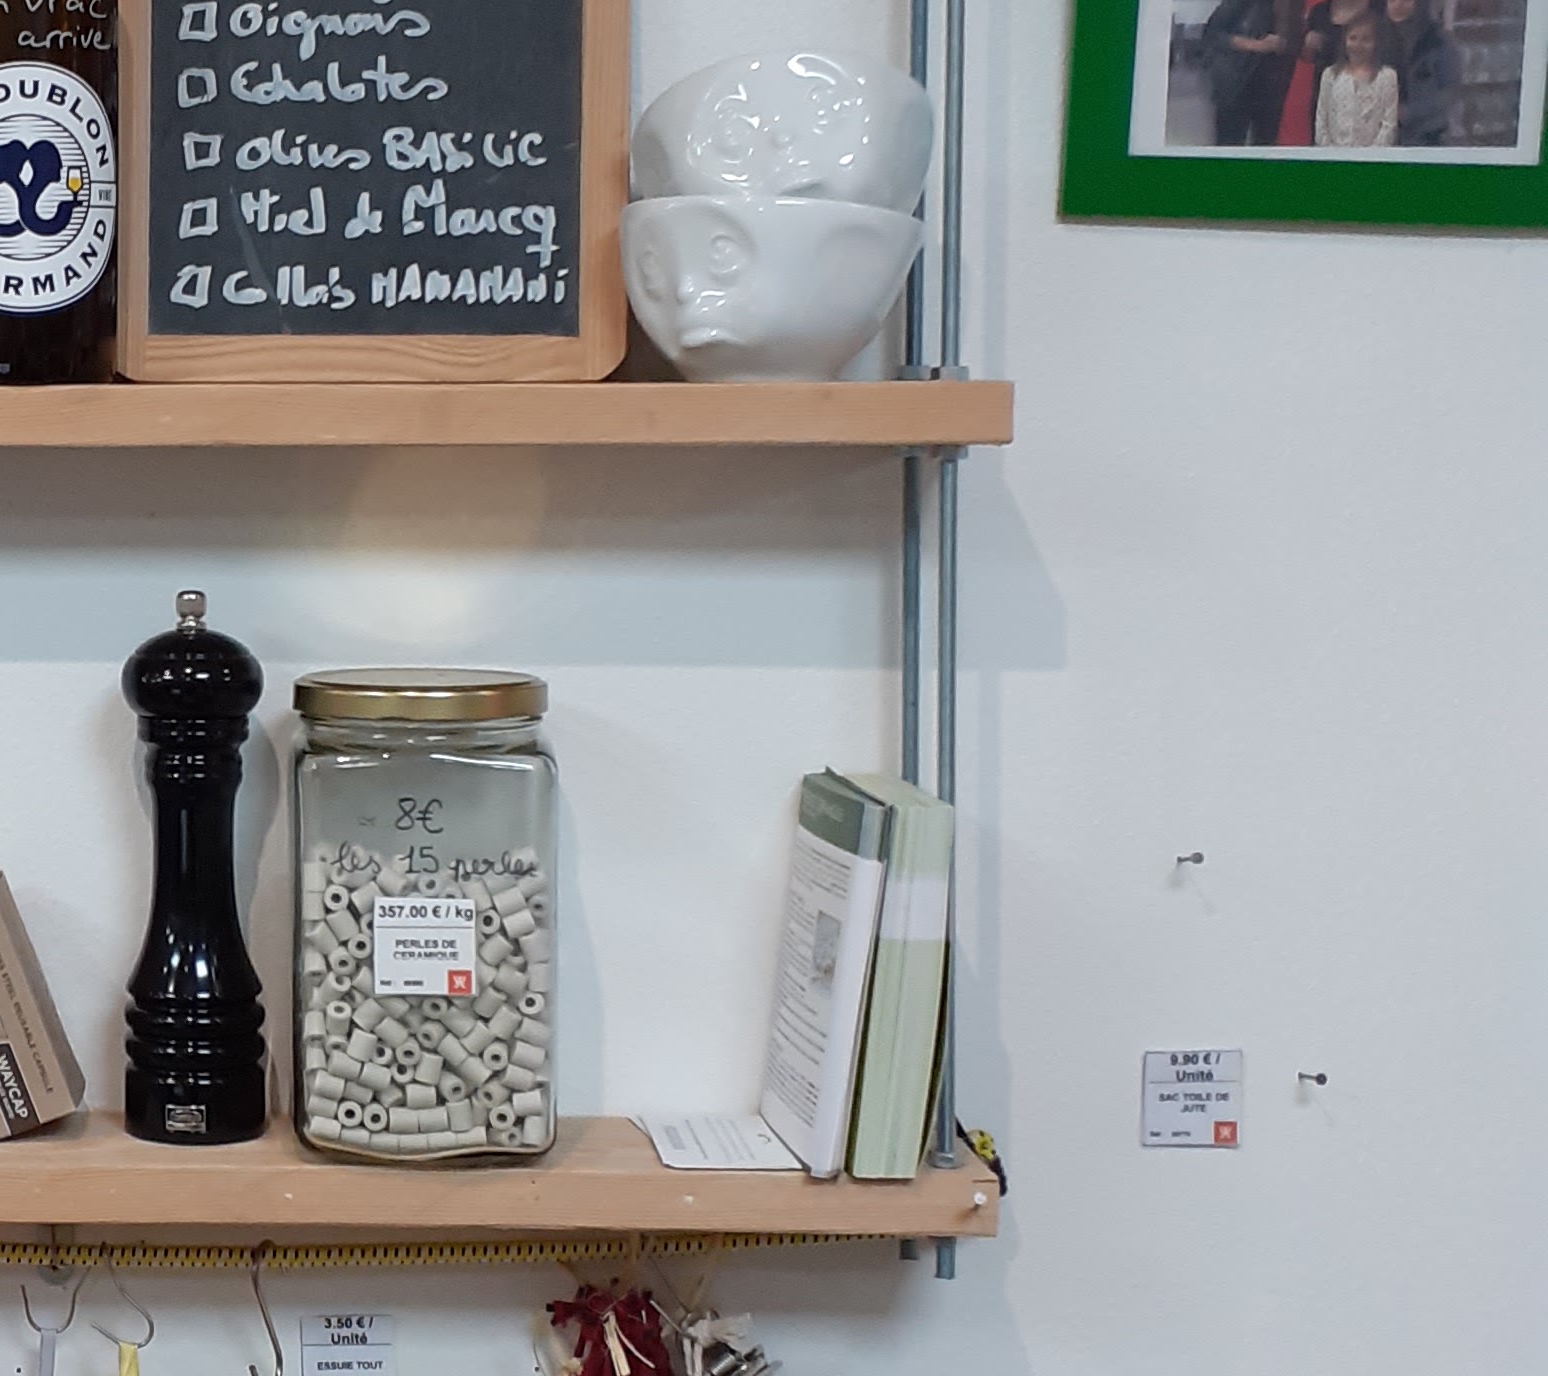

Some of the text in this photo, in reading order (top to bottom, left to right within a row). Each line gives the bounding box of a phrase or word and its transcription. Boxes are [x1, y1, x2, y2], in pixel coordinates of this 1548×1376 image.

[17, 25, 112, 50] arrive
[235, 128, 372, 171] Olives
[331, 841, 538, 882] les 15 perles
[378, 905, 428, 918] 357.00
[431, 905, 442, 918] €
[454, 905, 474, 922] kg
[395, 939, 457, 949] PERLES DE
[393, 951, 459, 961] CERAMIQUE
[1203, 1053, 1212, 1065] €
[1176, 1069, 1214, 1082] Unité
[1159, 1093, 1229, 1102] SAC TOILE DE
[1181, 1104, 1206, 1113] JUTE
[324, 1317, 353, 1329] 3.50
[356, 1316, 366, 1329] €
[330, 1332, 368, 1344] Unité
[317, 1361, 384, 1370] ESSUIE TOUT
